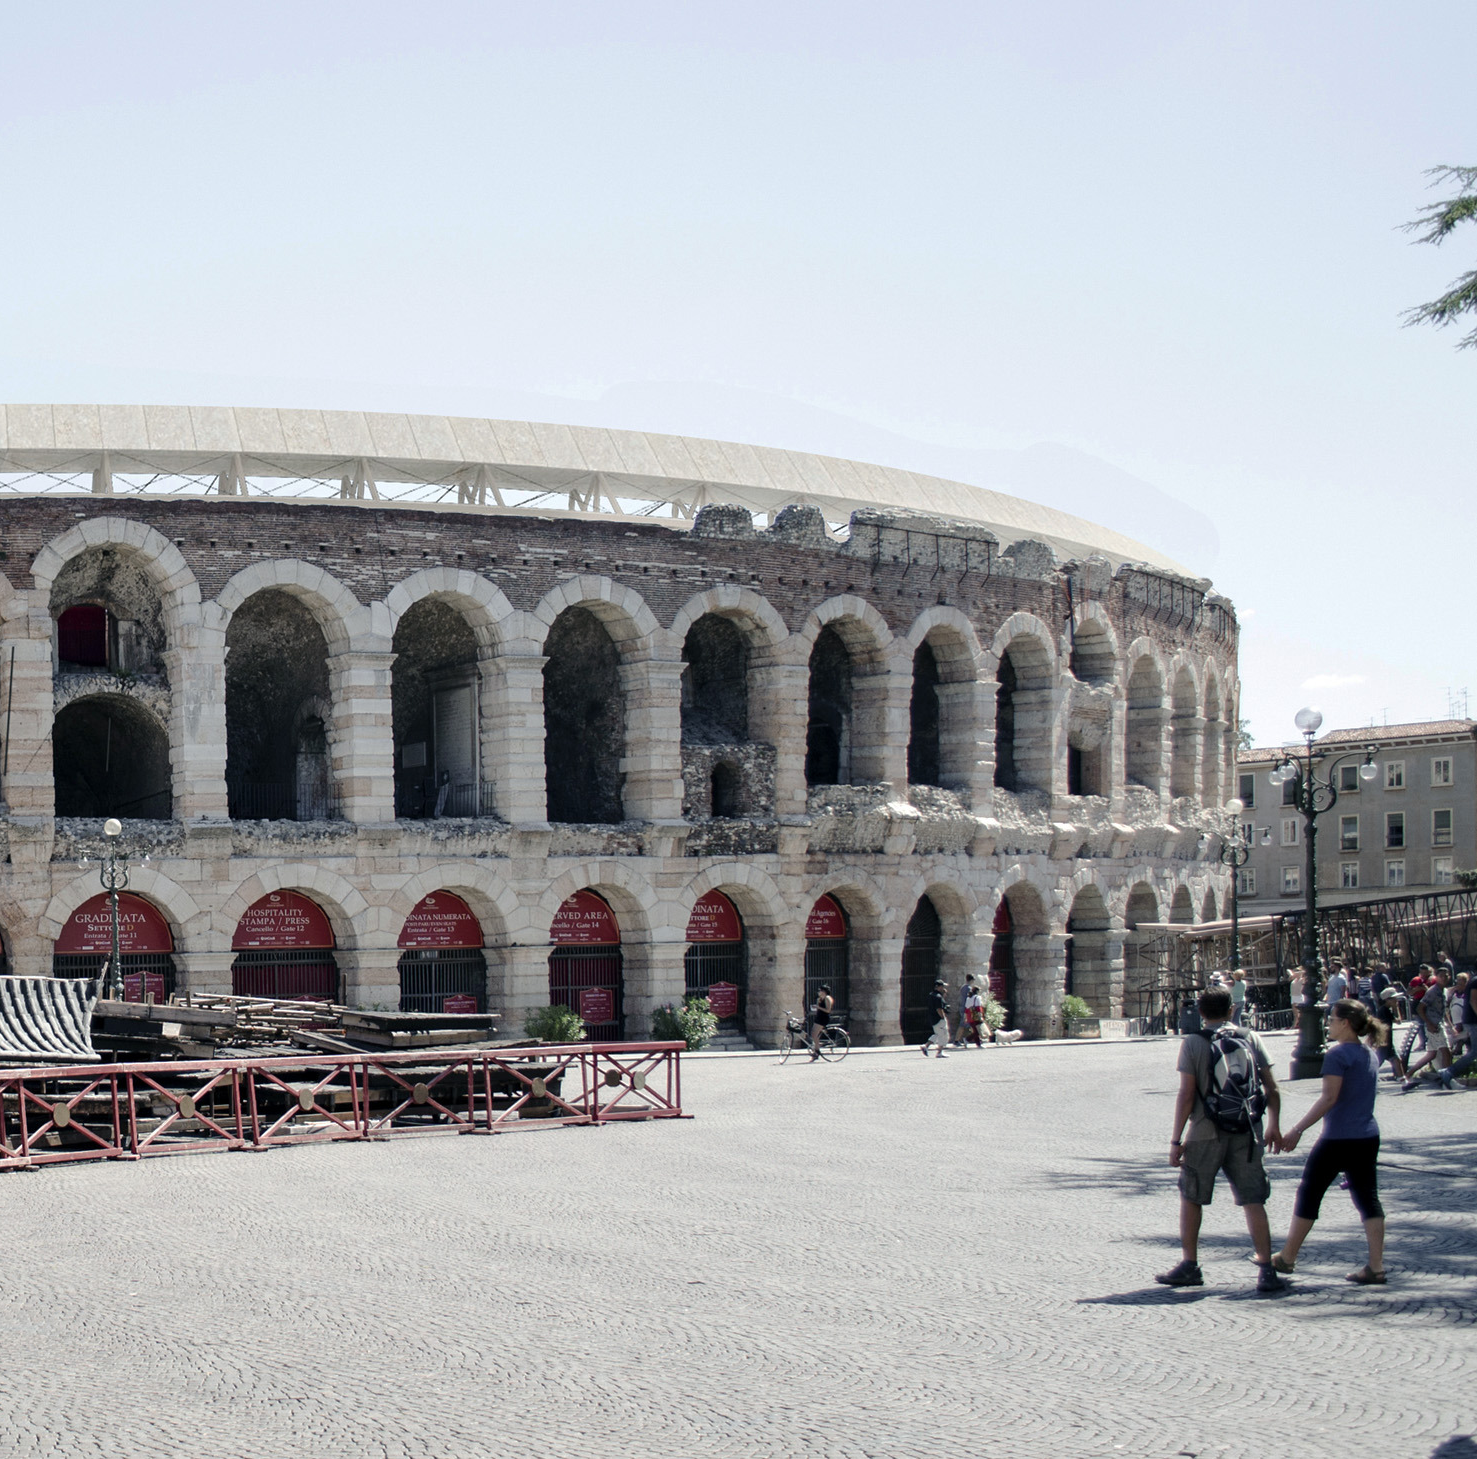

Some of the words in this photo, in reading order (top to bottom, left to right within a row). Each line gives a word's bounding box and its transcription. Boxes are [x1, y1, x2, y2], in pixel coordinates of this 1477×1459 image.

[247, 909, 303, 917] HOSPITALITY
[584, 912, 609, 920] AREA
[285, 917, 310, 925] PRESS
